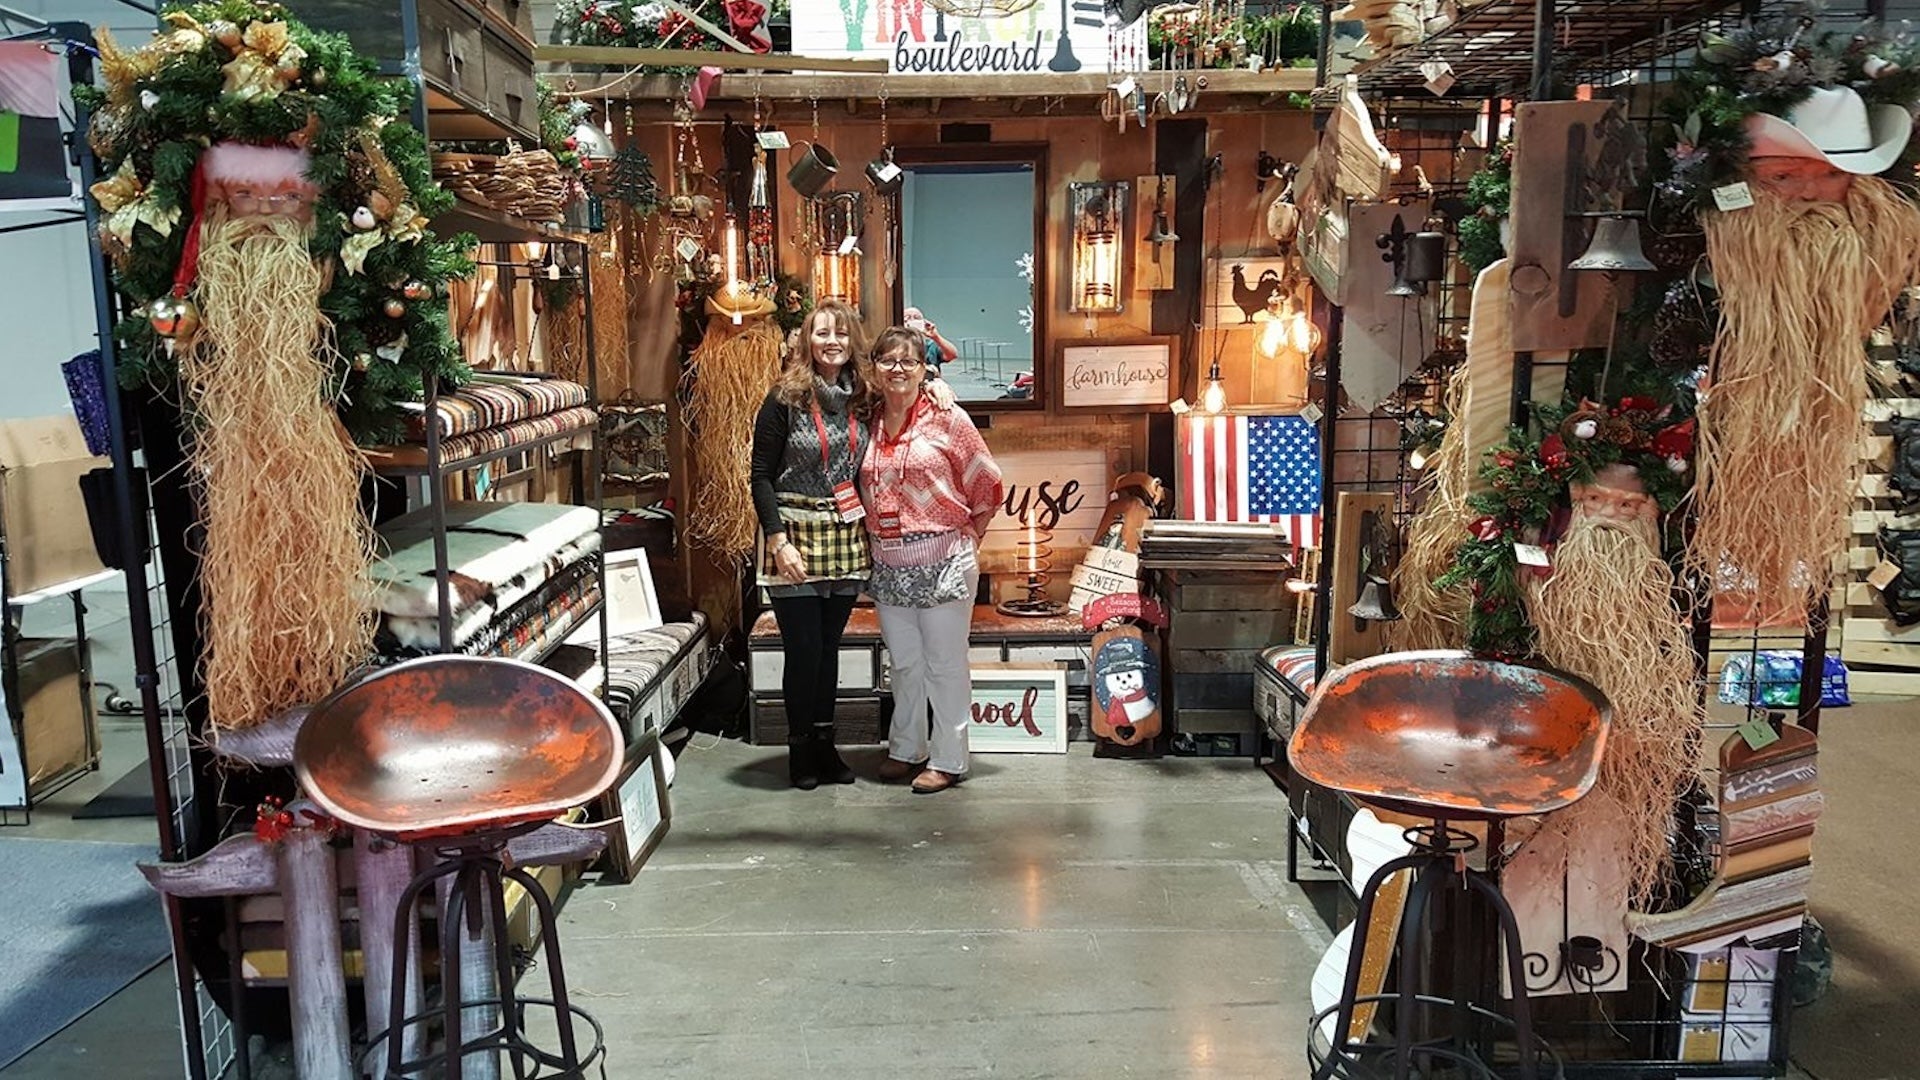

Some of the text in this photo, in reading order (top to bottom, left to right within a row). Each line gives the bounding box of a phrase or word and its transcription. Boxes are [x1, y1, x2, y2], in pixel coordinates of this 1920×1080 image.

[894, 30, 1043, 72] boulevard
[1067, 361, 1169, 390] farmhouse
[1086, 572, 1124, 593] SWEET
